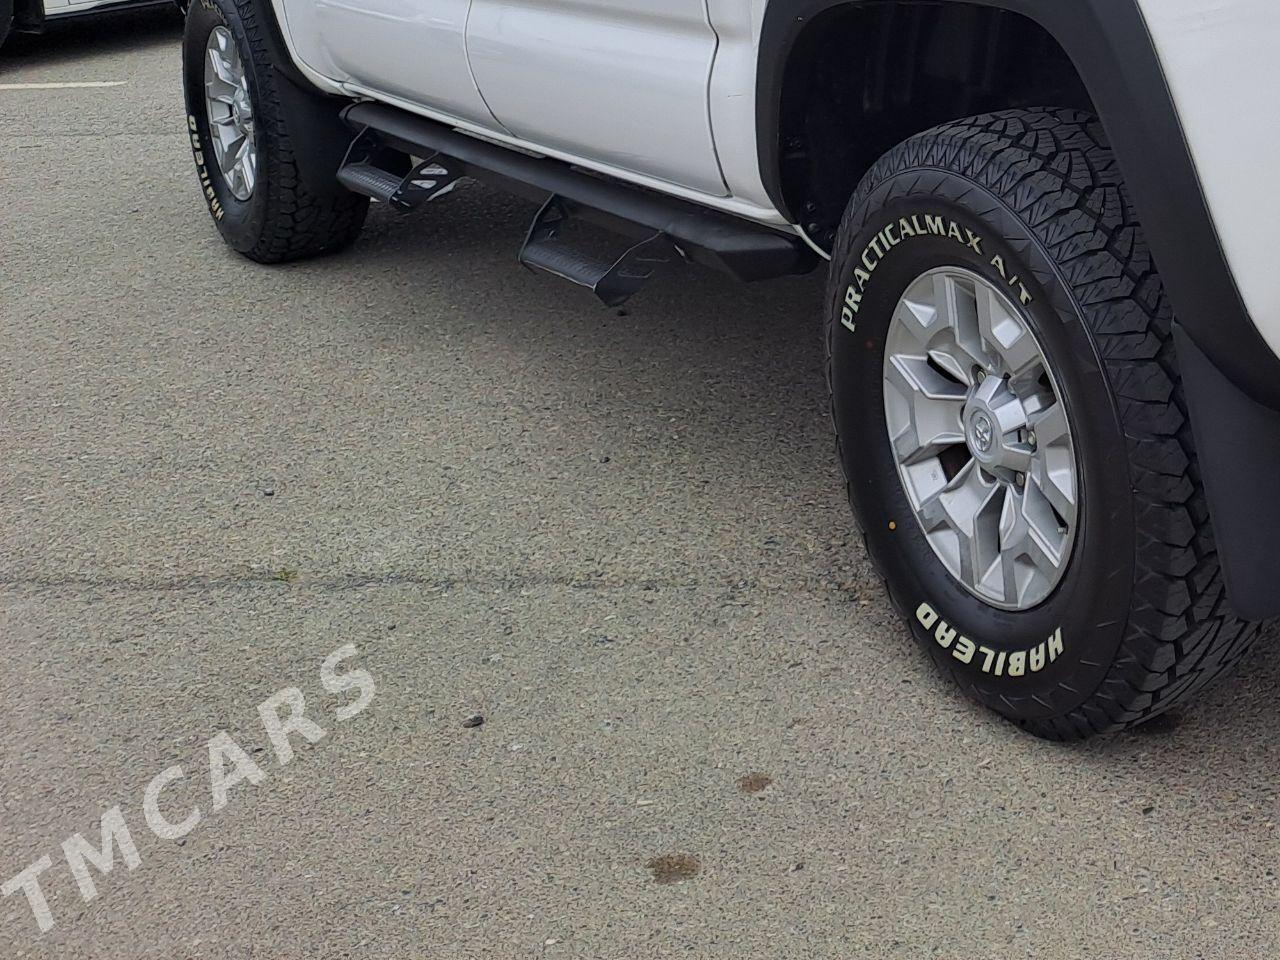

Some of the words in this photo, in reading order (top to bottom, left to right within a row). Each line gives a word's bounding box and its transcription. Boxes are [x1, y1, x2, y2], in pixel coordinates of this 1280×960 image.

[840, 214, 983, 333] PRACTICALMAX
[990, 254, 1033, 306] A/T
[915, 602, 1065, 677] HABILEAD
